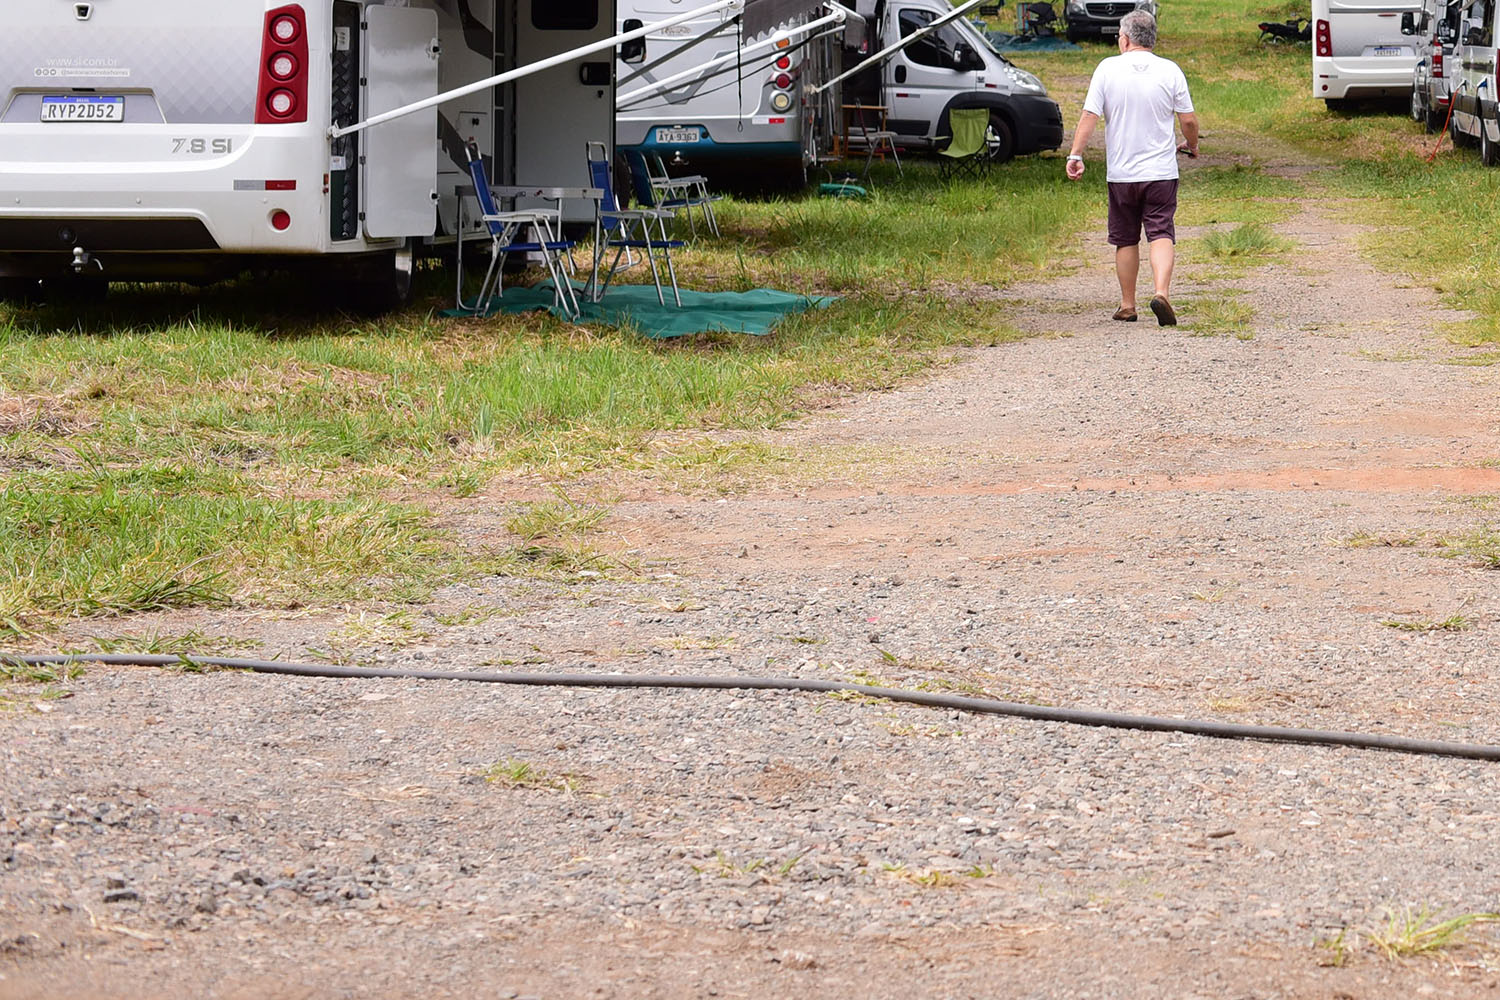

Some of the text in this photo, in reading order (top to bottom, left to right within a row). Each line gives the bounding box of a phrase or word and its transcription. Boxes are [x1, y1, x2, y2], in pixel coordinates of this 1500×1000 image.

[48, 104, 115, 118] RYP2D52
[171, 138, 232, 154] 7.8 SI
